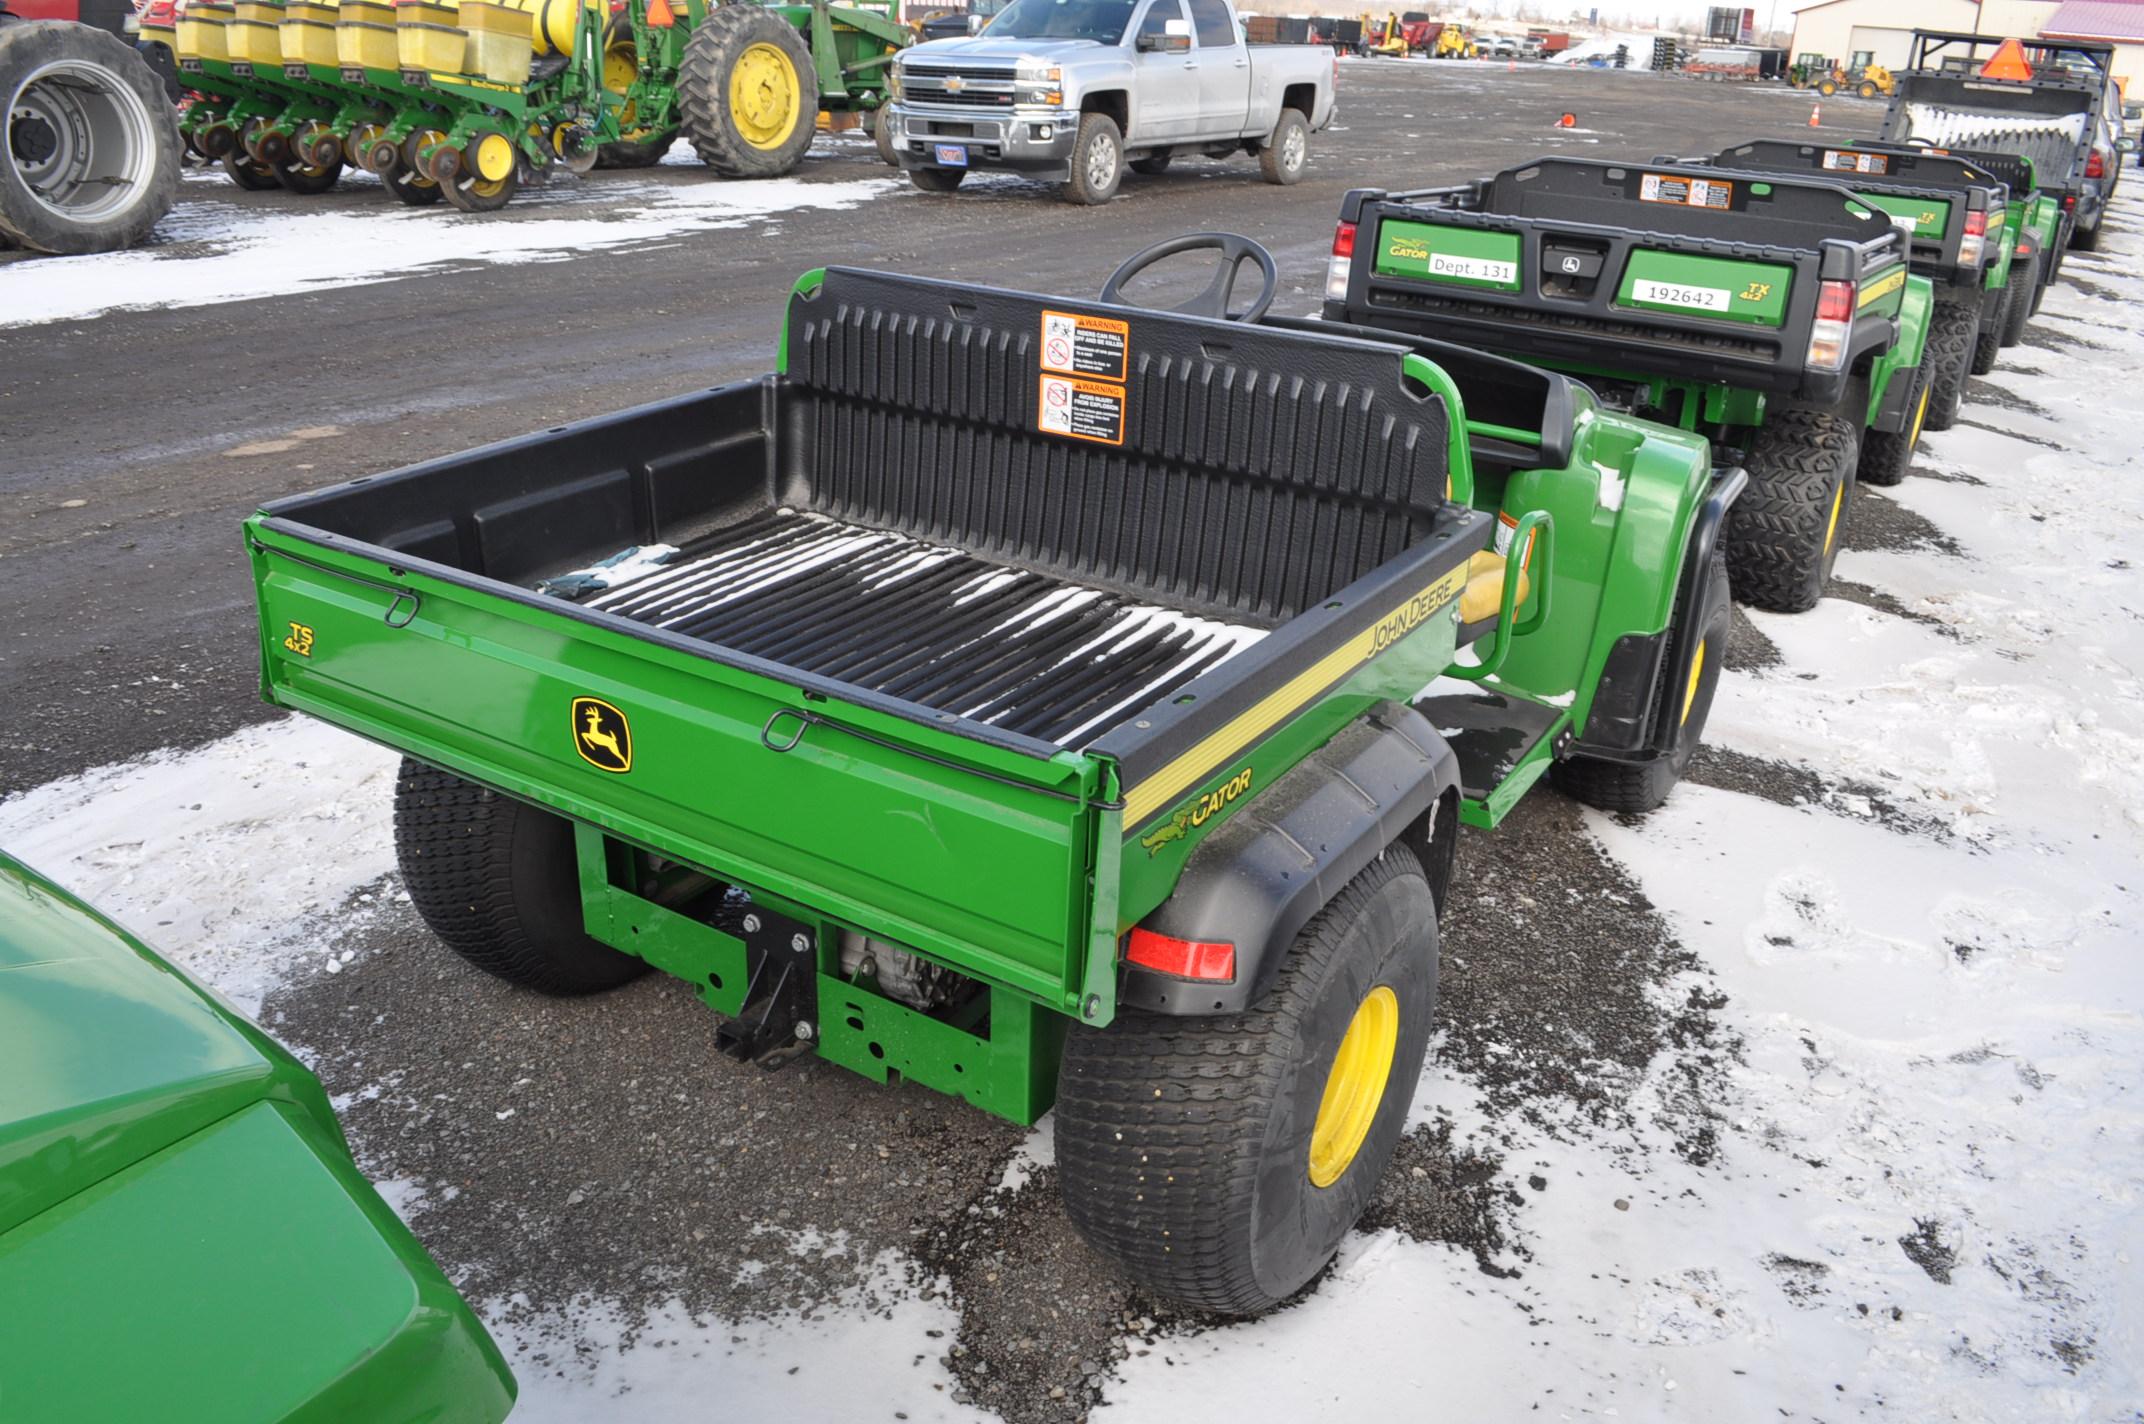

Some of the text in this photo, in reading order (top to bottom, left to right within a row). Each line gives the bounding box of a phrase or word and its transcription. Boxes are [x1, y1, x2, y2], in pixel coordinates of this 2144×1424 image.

[1390, 245, 1428, 259] GATOR
[1434, 258, 1510, 279] Dept. 131
[1648, 286, 1715, 306] 192642
[1749, 282, 1771, 296] TX
[1085, 319, 1122, 331] WARNING
[1082, 383, 1120, 396] WARNING
[1367, 577, 1453, 656] JOHN DEERE
[289, 621, 314, 646] TS
[284, 635, 311, 658] 4x2
[1191, 766, 1253, 827] GATOR
